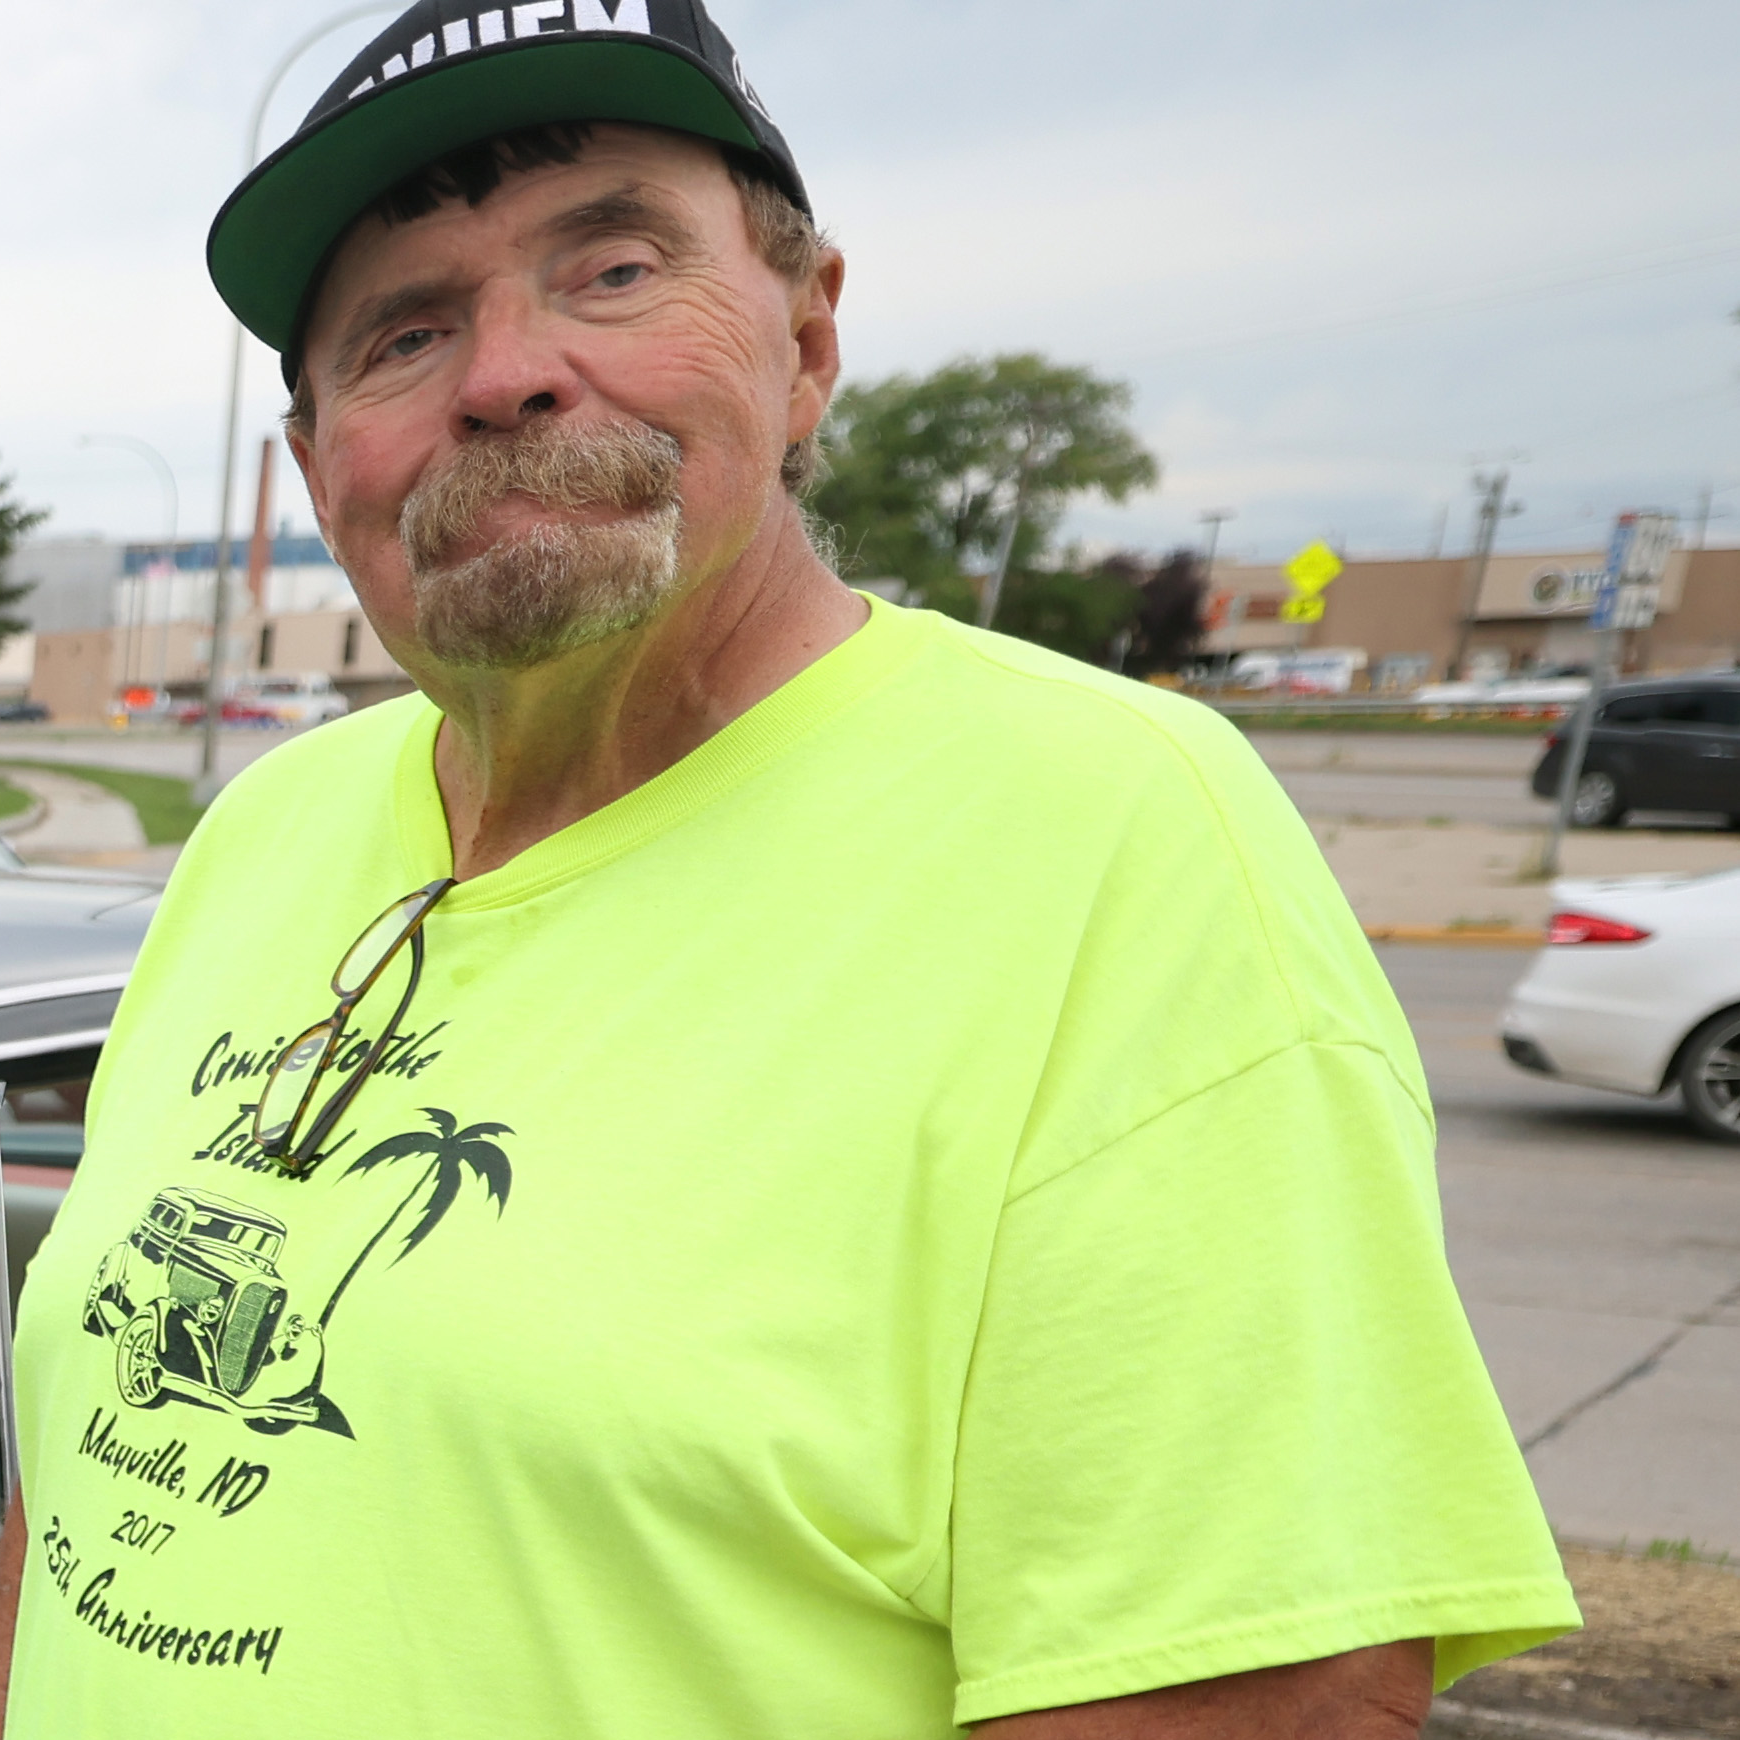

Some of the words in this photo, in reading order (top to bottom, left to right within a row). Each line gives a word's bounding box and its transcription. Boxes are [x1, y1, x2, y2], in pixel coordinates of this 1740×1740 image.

[370, 1019, 455, 1080] the
[78, 1406, 188, 1499] Mayville,
[195, 1456, 270, 1519] ND
[110, 1510, 176, 1556] 2017
[43, 1515, 81, 1598] 25th
[75, 1567, 283, 1676] Anniversary
